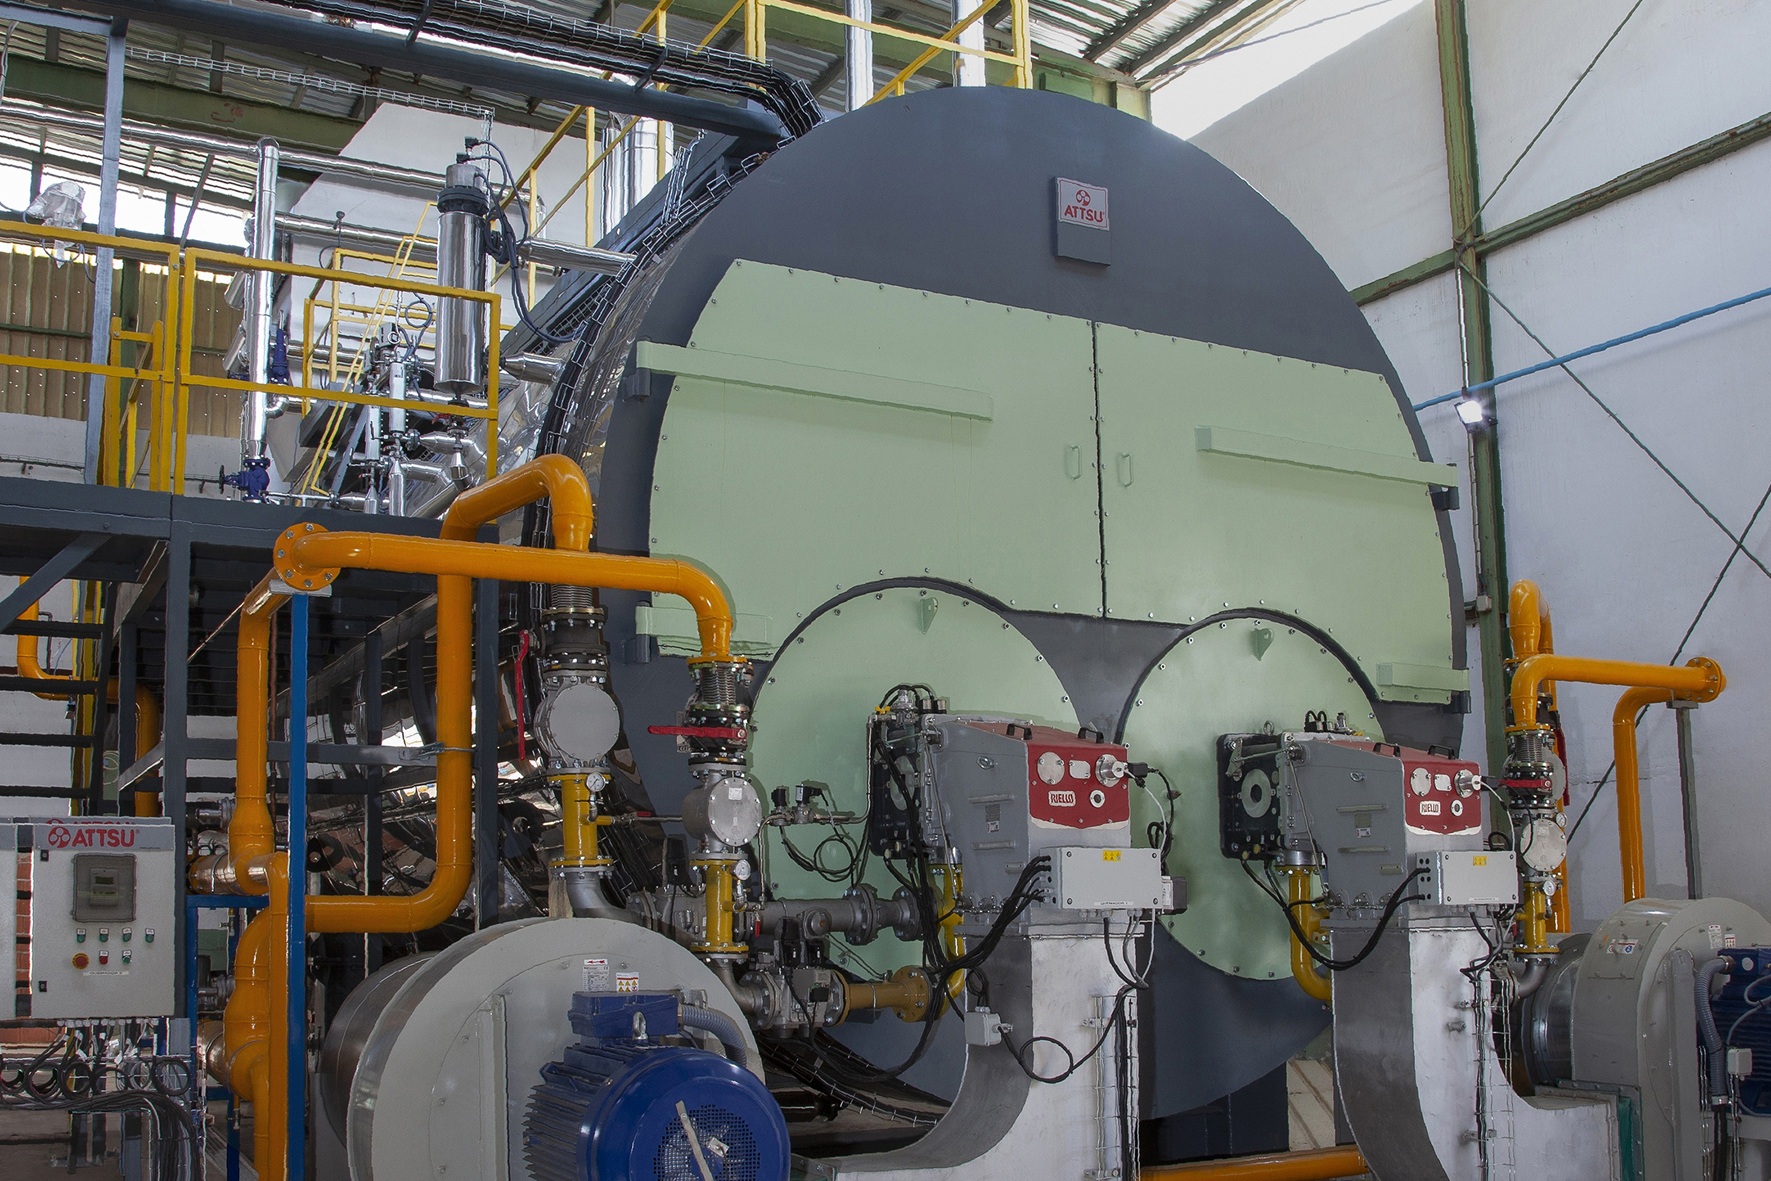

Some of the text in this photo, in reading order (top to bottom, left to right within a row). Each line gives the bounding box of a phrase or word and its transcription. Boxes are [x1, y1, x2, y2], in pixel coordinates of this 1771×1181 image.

[1064, 204, 1103, 223] ATTSU
[1050, 793, 1074, 804] RIELLO
[71, 828, 136, 848] ATTSU
